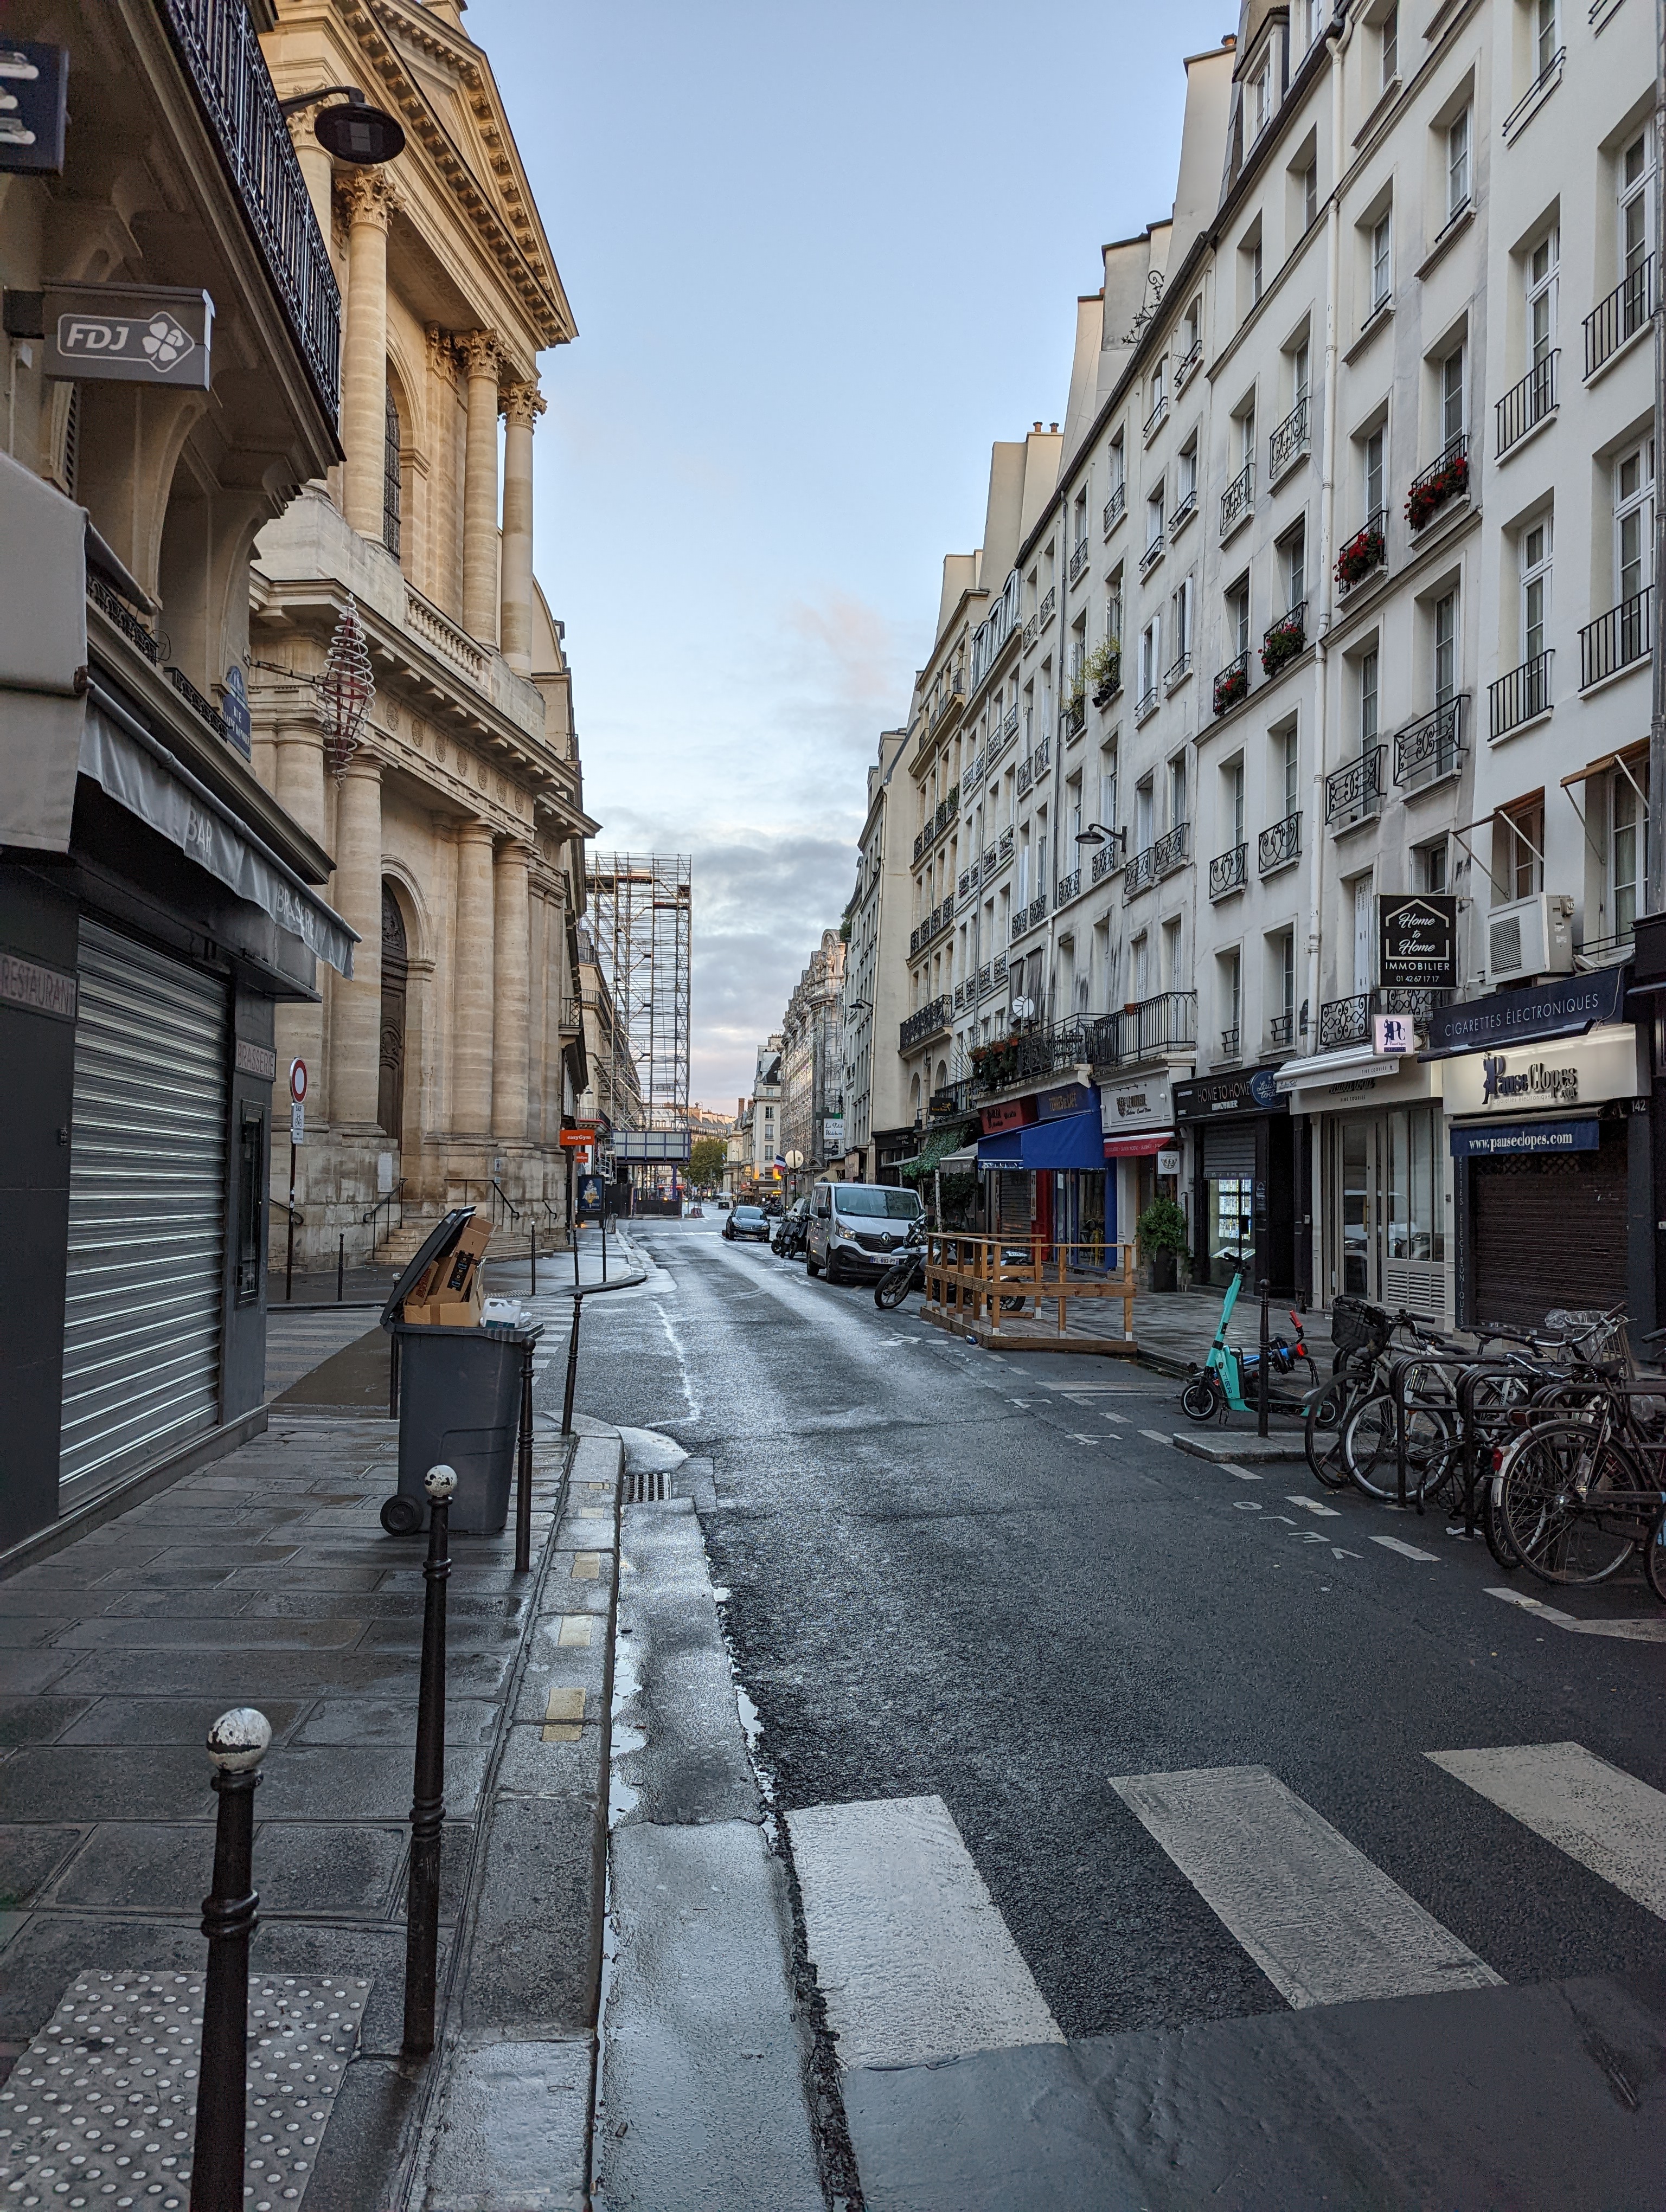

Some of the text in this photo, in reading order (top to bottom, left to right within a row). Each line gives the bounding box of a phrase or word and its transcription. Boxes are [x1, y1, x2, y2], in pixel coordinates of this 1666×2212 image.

[66, 323, 129, 350] FDJ
[233, 706, 242, 723] RUE
[186, 806, 212, 857] BAR
[1399, 912, 1436, 929] Home
[1412, 929, 1421, 938] to
[1399, 939, 1436, 955] Home
[1386, 962, 1450, 970] IMMOBILIER
[1445, 993, 1598, 1037] CIGARETTES ÉLECTRONIQUES
[238, 1044, 274, 1076] BRASSERIE
[1198, 1086, 1217, 1103] HOME
[1219, 1085, 1227, 1099] TO
[1229, 1081, 1250, 1098] HOME
[1257, 1081, 1277, 1091] Laur
[1212, 1100, 1238, 1111] IMMOBILIER
[1632, 1099, 1646, 1112] 142
[1469, 1131, 1573, 1152] www.pauseclopes.com
[1222, 1371, 1232, 1394] TIER
